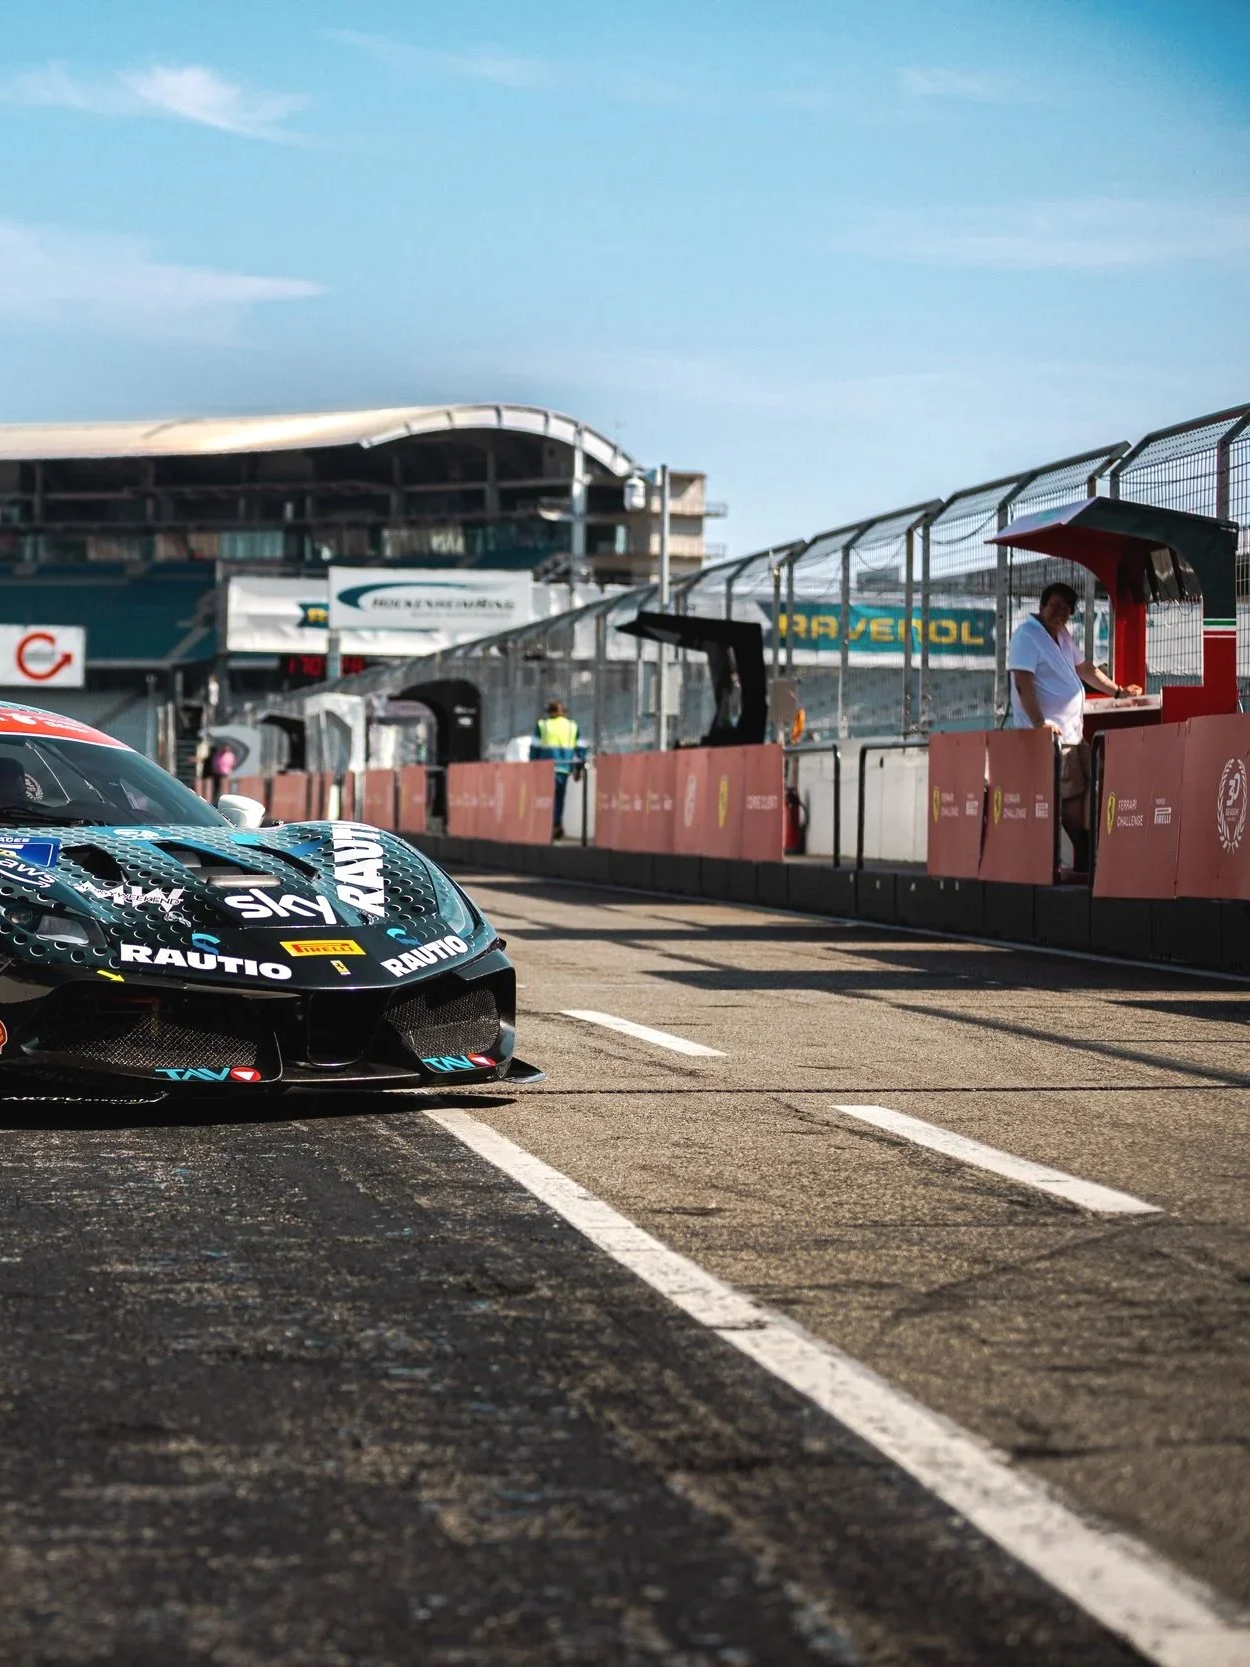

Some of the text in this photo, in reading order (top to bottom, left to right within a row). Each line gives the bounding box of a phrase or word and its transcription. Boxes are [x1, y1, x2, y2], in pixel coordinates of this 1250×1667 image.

[778, 614, 984, 645] RAVENOL
[1118, 798, 1138, 811] FERRARI
[1154, 807, 1172, 824] PIRELLI
[1116, 814, 1143, 827] CHALLENGE
[224, 888, 337, 925] sky
[291, 943, 354, 954] PIRELLI
[380, 935, 469, 977] RAUTIO
[120, 943, 292, 980] RAUTIO
